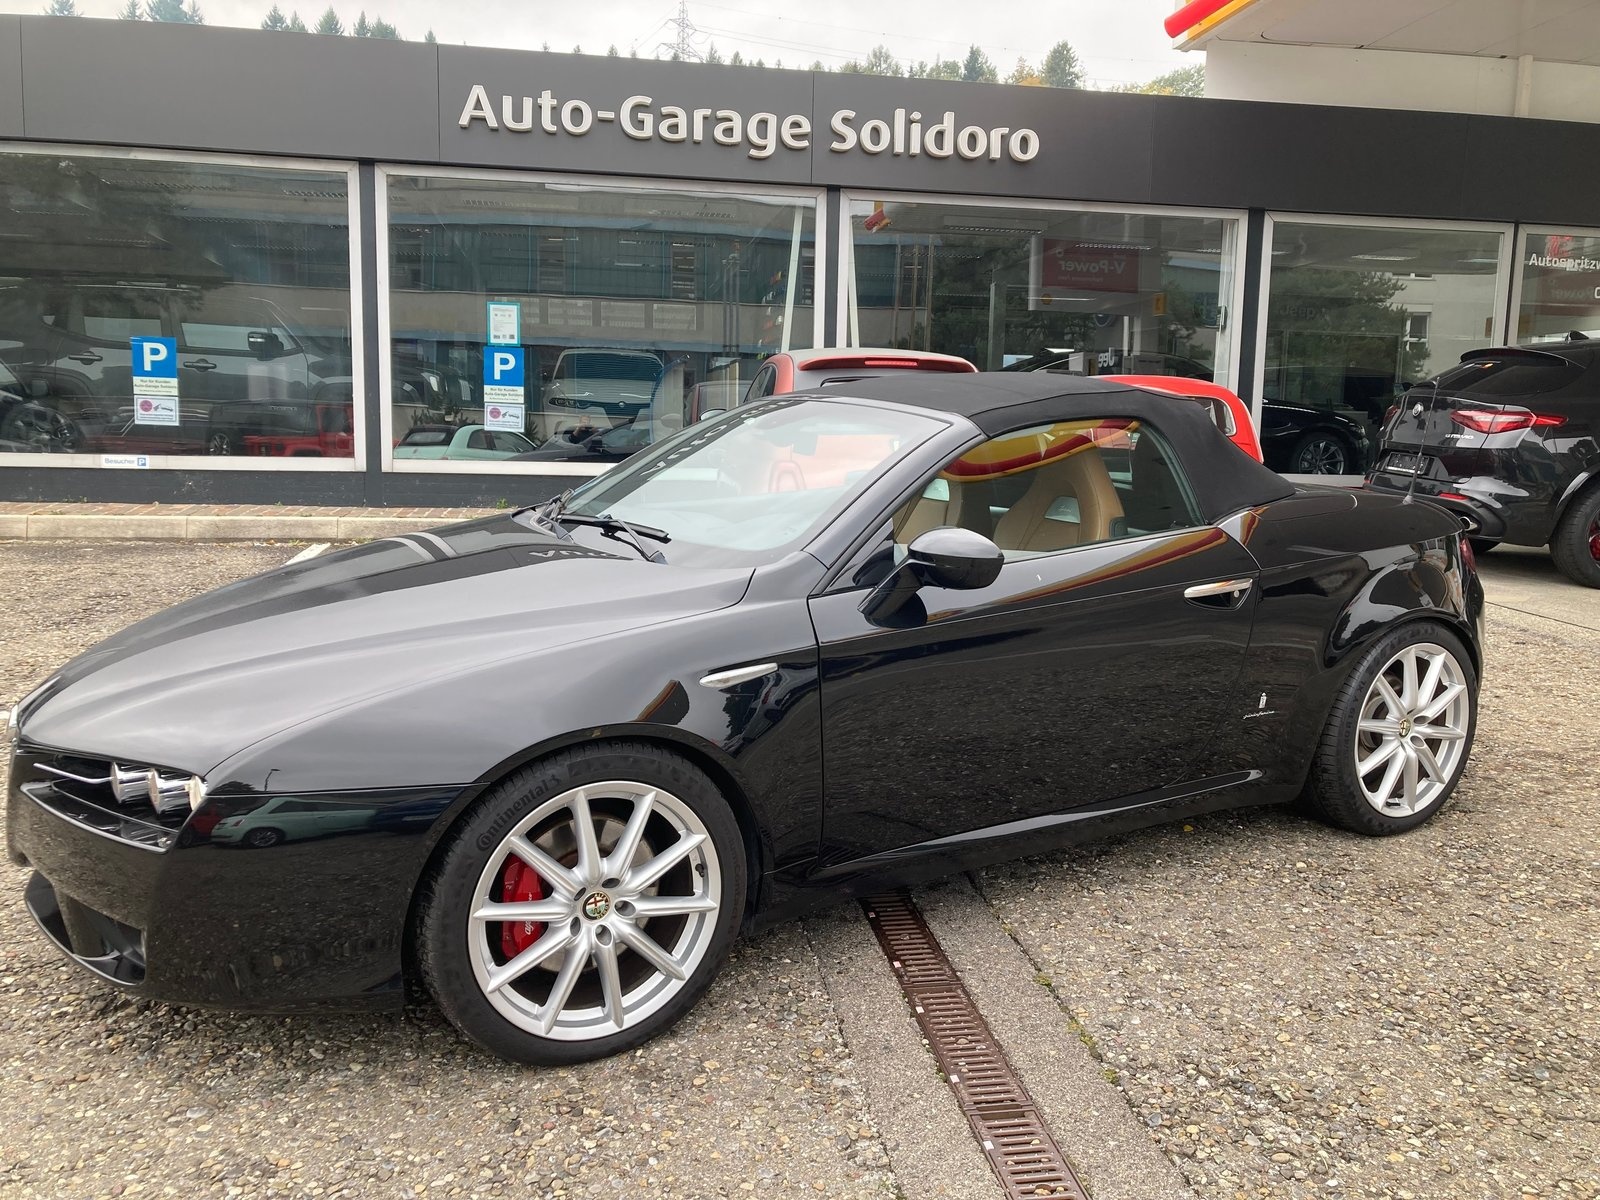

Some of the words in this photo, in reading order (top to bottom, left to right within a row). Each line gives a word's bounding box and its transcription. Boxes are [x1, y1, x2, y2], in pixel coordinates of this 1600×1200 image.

[458, 84, 811, 160] Auto-Garage
[830, 107, 1041, 163] Solidoro
[143, 342, 168, 371] P
[494, 352, 516, 380] P
[104, 457, 135, 465] Besucher
[476, 782, 550, 851] Continental
